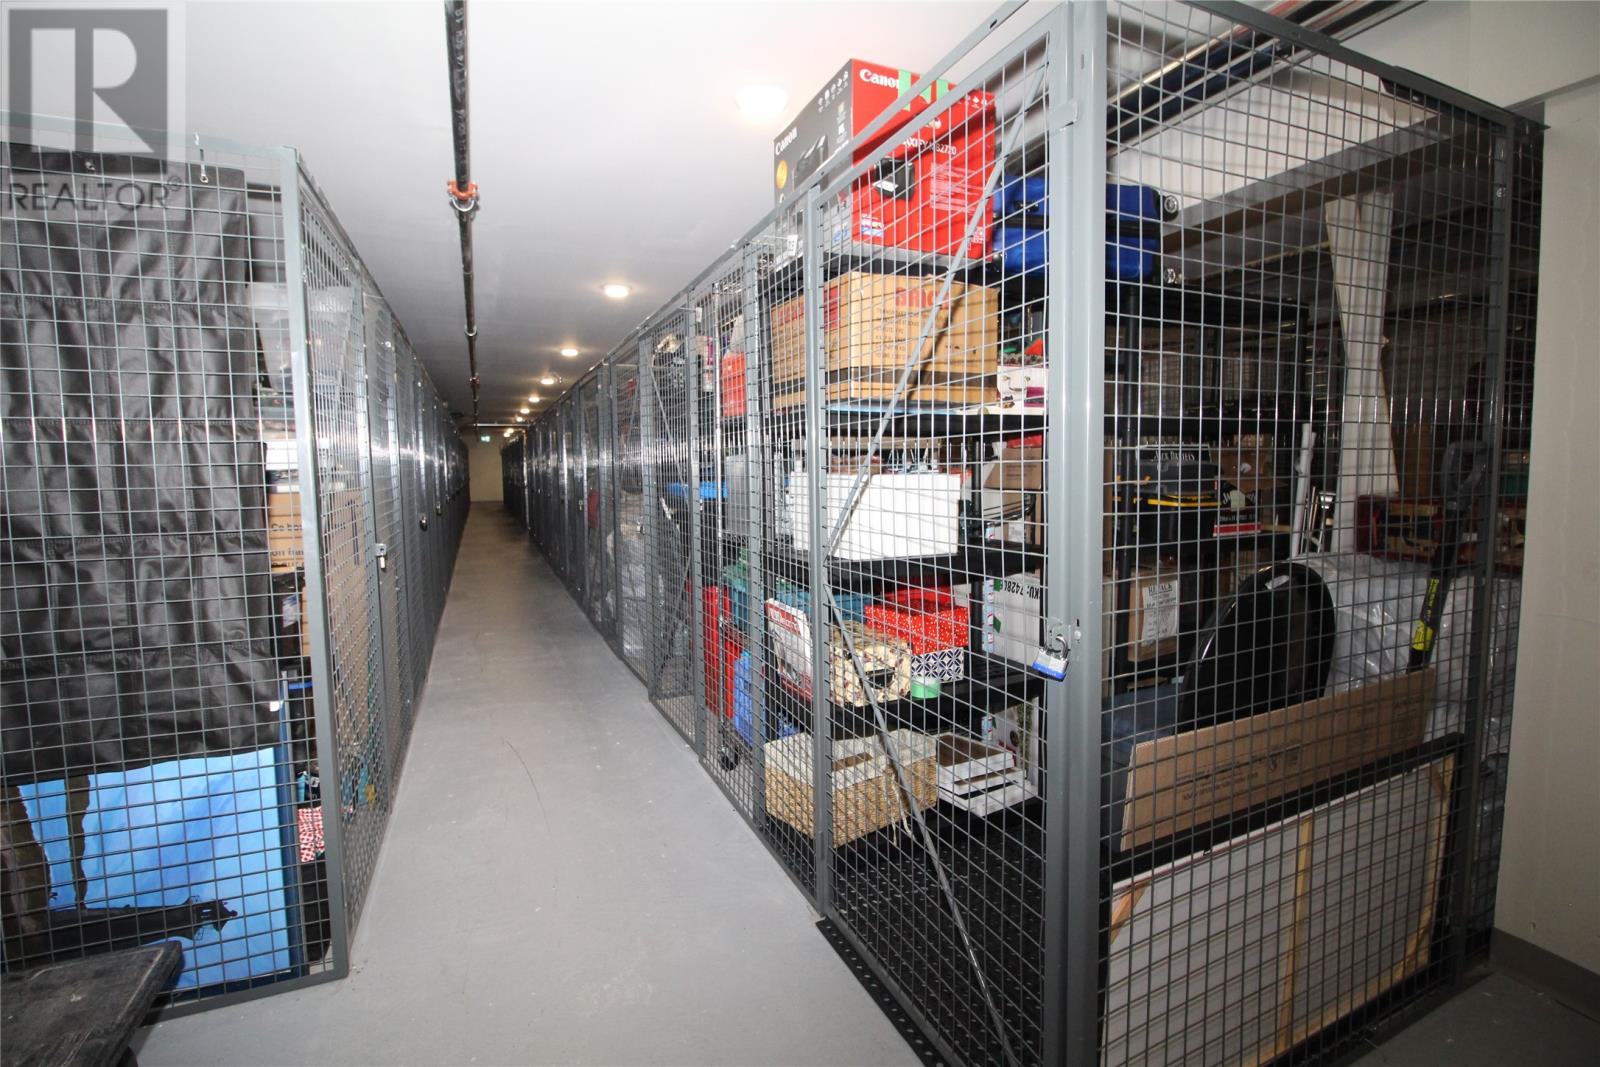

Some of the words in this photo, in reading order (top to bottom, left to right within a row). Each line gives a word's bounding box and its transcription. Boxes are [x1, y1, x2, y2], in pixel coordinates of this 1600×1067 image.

[859, 68, 899, 89] Cano
[775, 126, 798, 155] Canon
[1026, 585, 1041, 600] KU:
